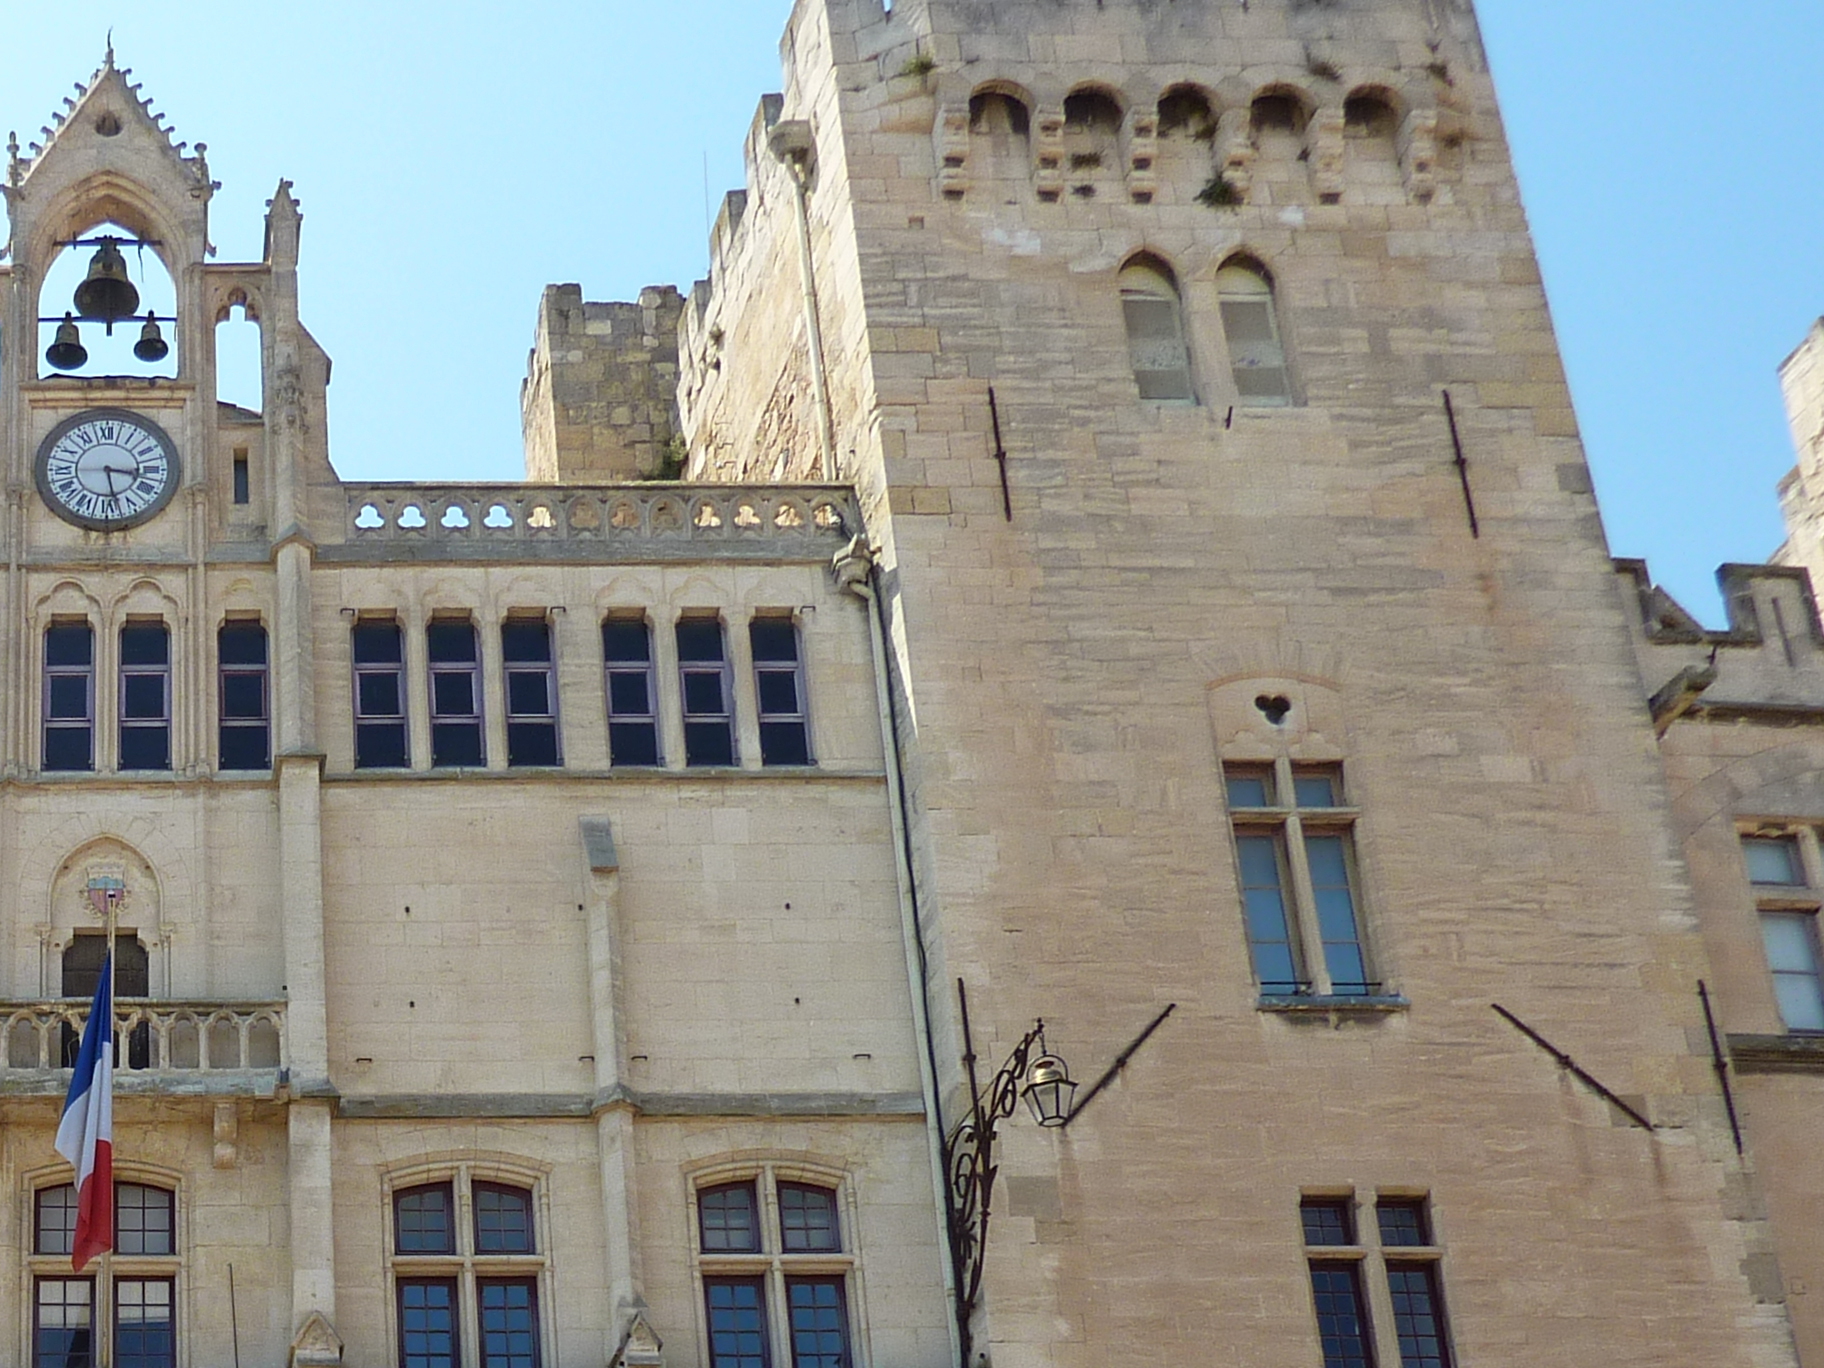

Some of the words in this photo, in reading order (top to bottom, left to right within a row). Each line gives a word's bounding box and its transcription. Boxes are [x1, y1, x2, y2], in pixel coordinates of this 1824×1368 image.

[77, 431, 92, 446] XI
[99, 426, 114, 440] XII
[60, 446, 78, 457] X
[54, 465, 72, 475] IX
[125, 496, 137, 508] V
